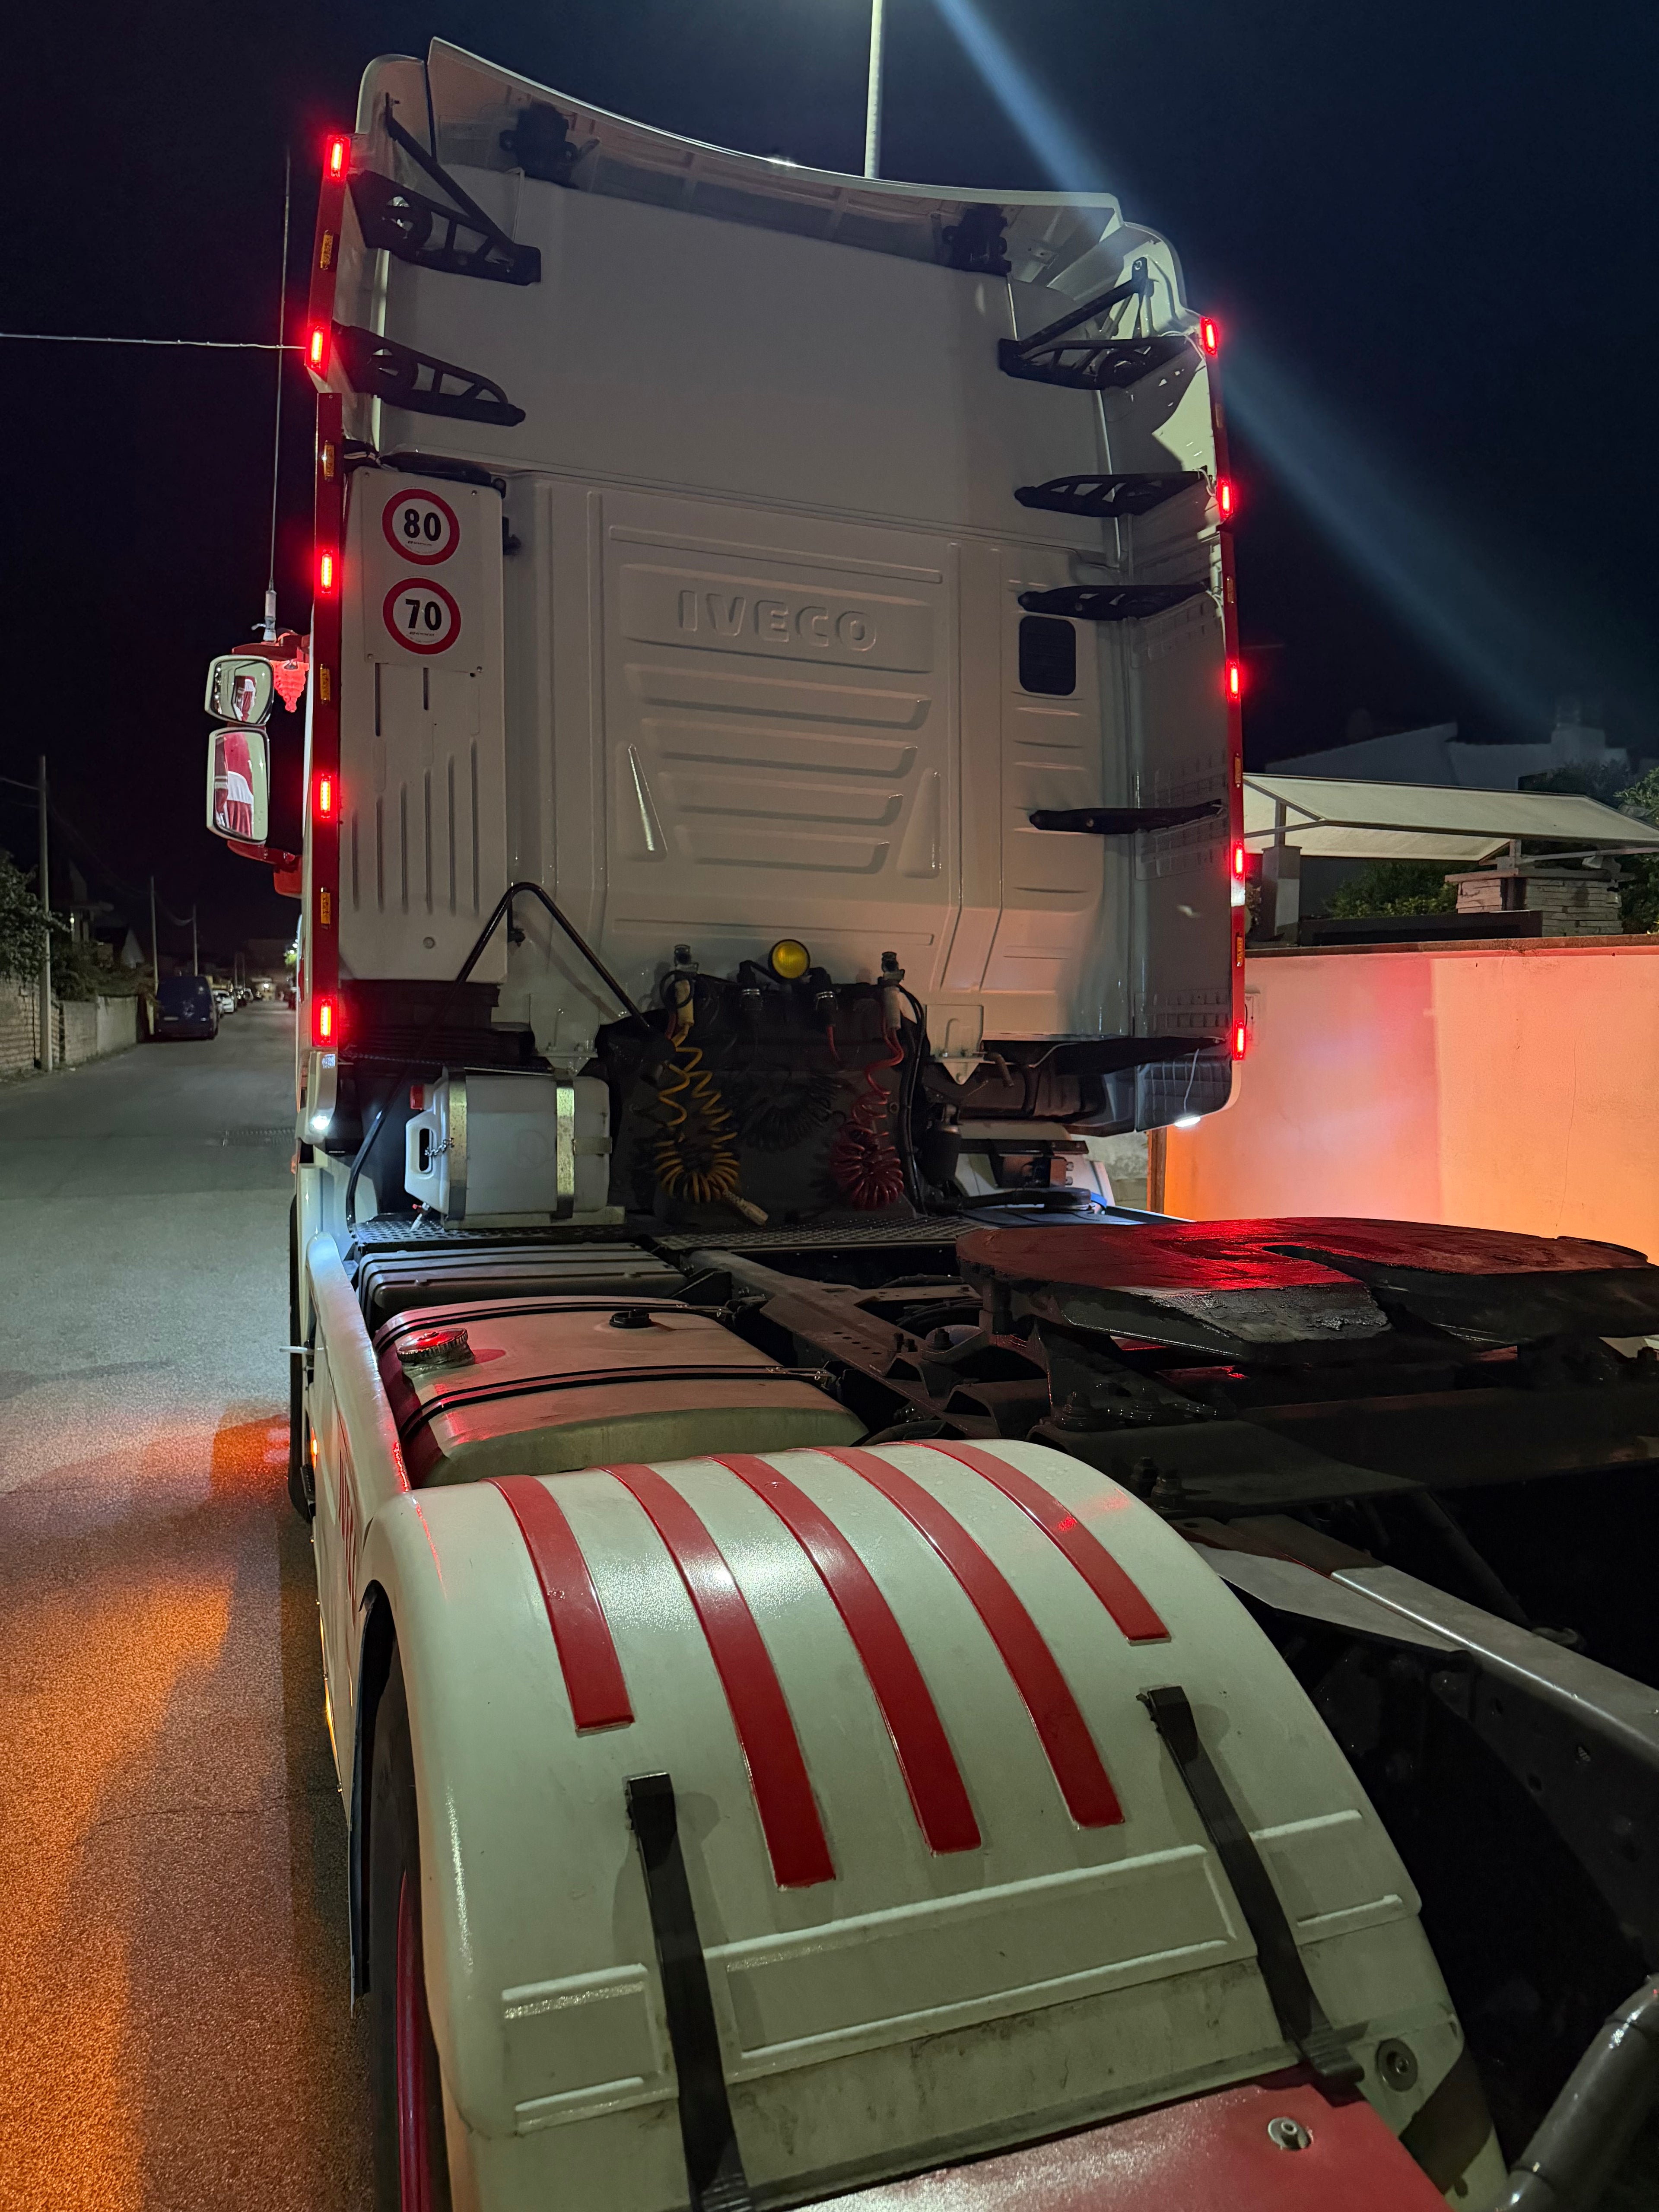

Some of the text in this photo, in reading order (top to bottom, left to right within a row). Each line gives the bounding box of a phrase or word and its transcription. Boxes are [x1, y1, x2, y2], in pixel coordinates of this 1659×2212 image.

[404, 509, 441, 541] 80
[405, 598, 442, 631] 70
[677, 590, 877, 651] IVECO
